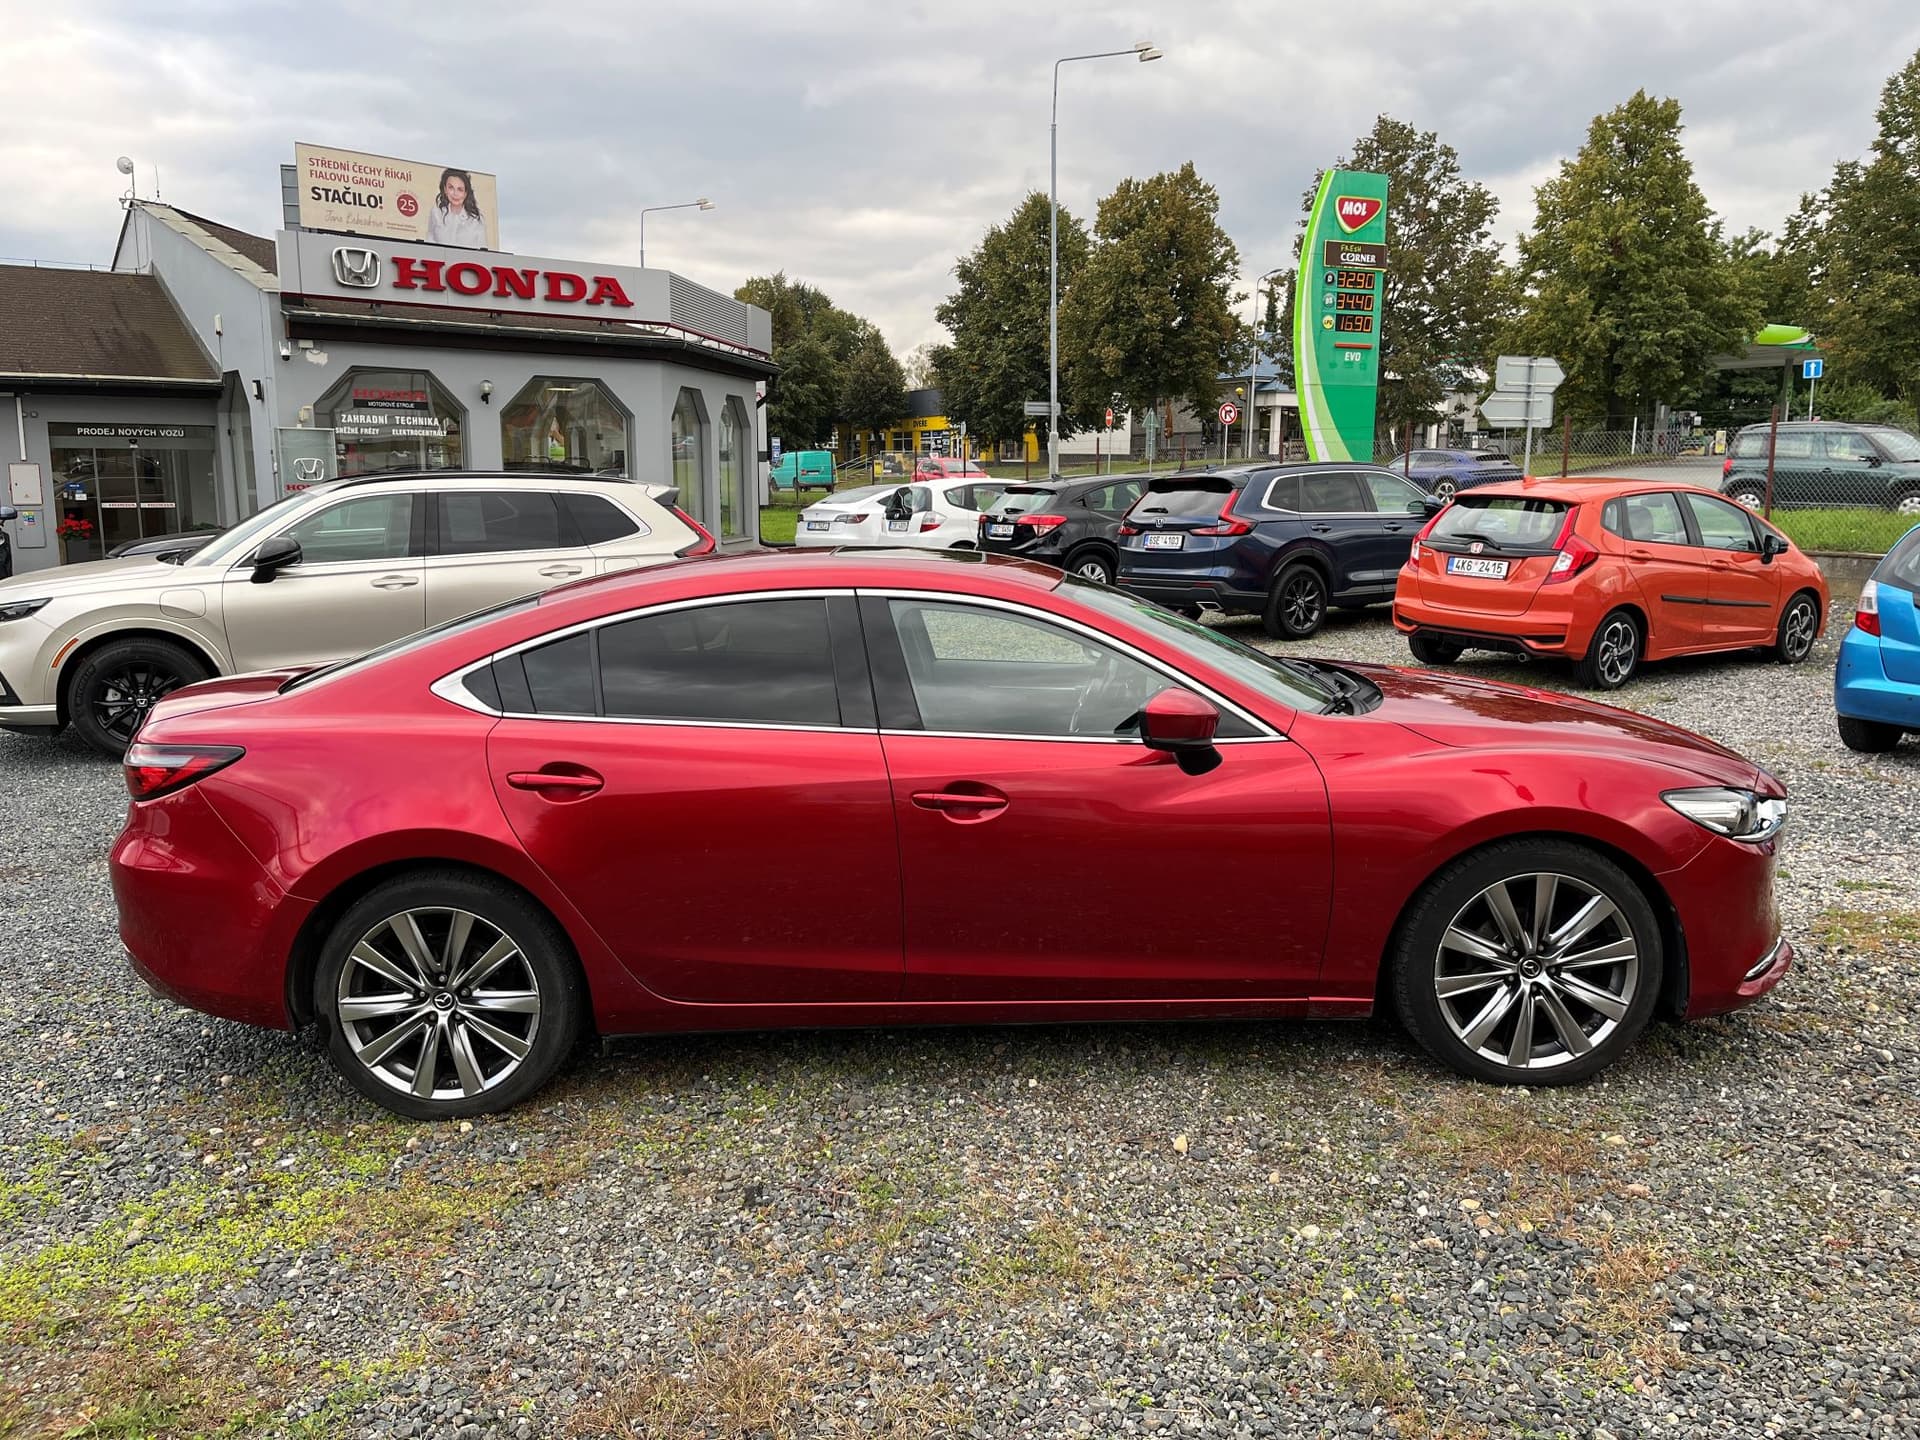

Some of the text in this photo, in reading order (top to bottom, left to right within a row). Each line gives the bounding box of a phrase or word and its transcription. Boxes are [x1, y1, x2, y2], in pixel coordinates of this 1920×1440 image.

[309, 157, 412, 182] STŘEDNÍ ČECHY ŘÍKAJÍ
[310, 169, 385, 188] FIALOVU GANGU
[311, 186, 383, 210] STAČILO!
[399, 198, 416, 212] 25
[1342, 201, 1367, 216] MOL
[1340, 252, 1376, 264] CORNER
[391, 256, 635, 308] HONDA
[1344, 352, 1362, 362] EVO
[341, 413, 440, 426] ZAHRADNÍ TECHNIKA
[77, 427, 115, 436] PRODEJ
[118, 426, 157, 437] NOVÝCH
[1455, 559, 1504, 574] 4K6 2415
